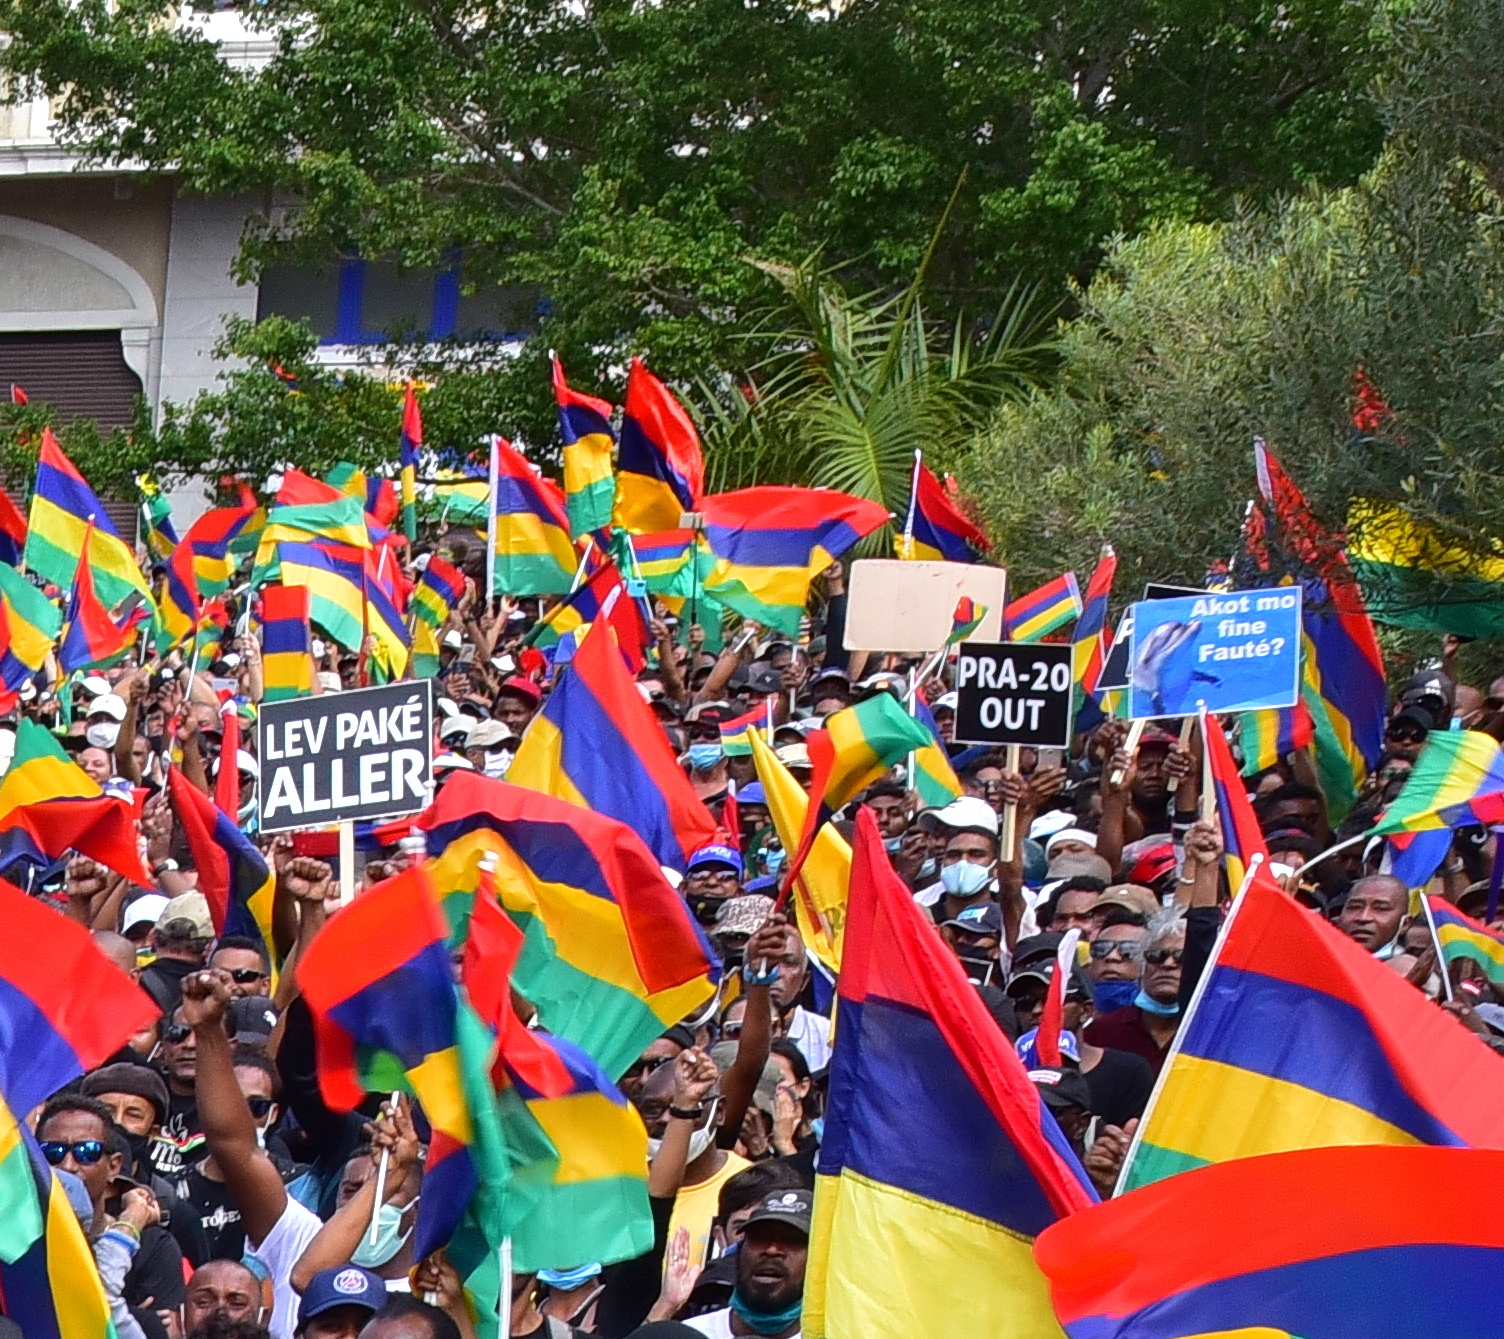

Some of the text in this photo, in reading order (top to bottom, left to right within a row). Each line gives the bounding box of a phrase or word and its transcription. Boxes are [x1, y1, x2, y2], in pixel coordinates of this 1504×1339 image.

[1190, 594, 1296, 618] Akot mo
[1217, 619, 1267, 638] fine
[1198, 636, 1285, 663] Fauté?
[959, 656, 1070, 692] PRA-20
[266, 694, 423, 760] LEV PAKÉ
[980, 697, 1046, 731] OUT
[263, 749, 429, 818] ALLER
